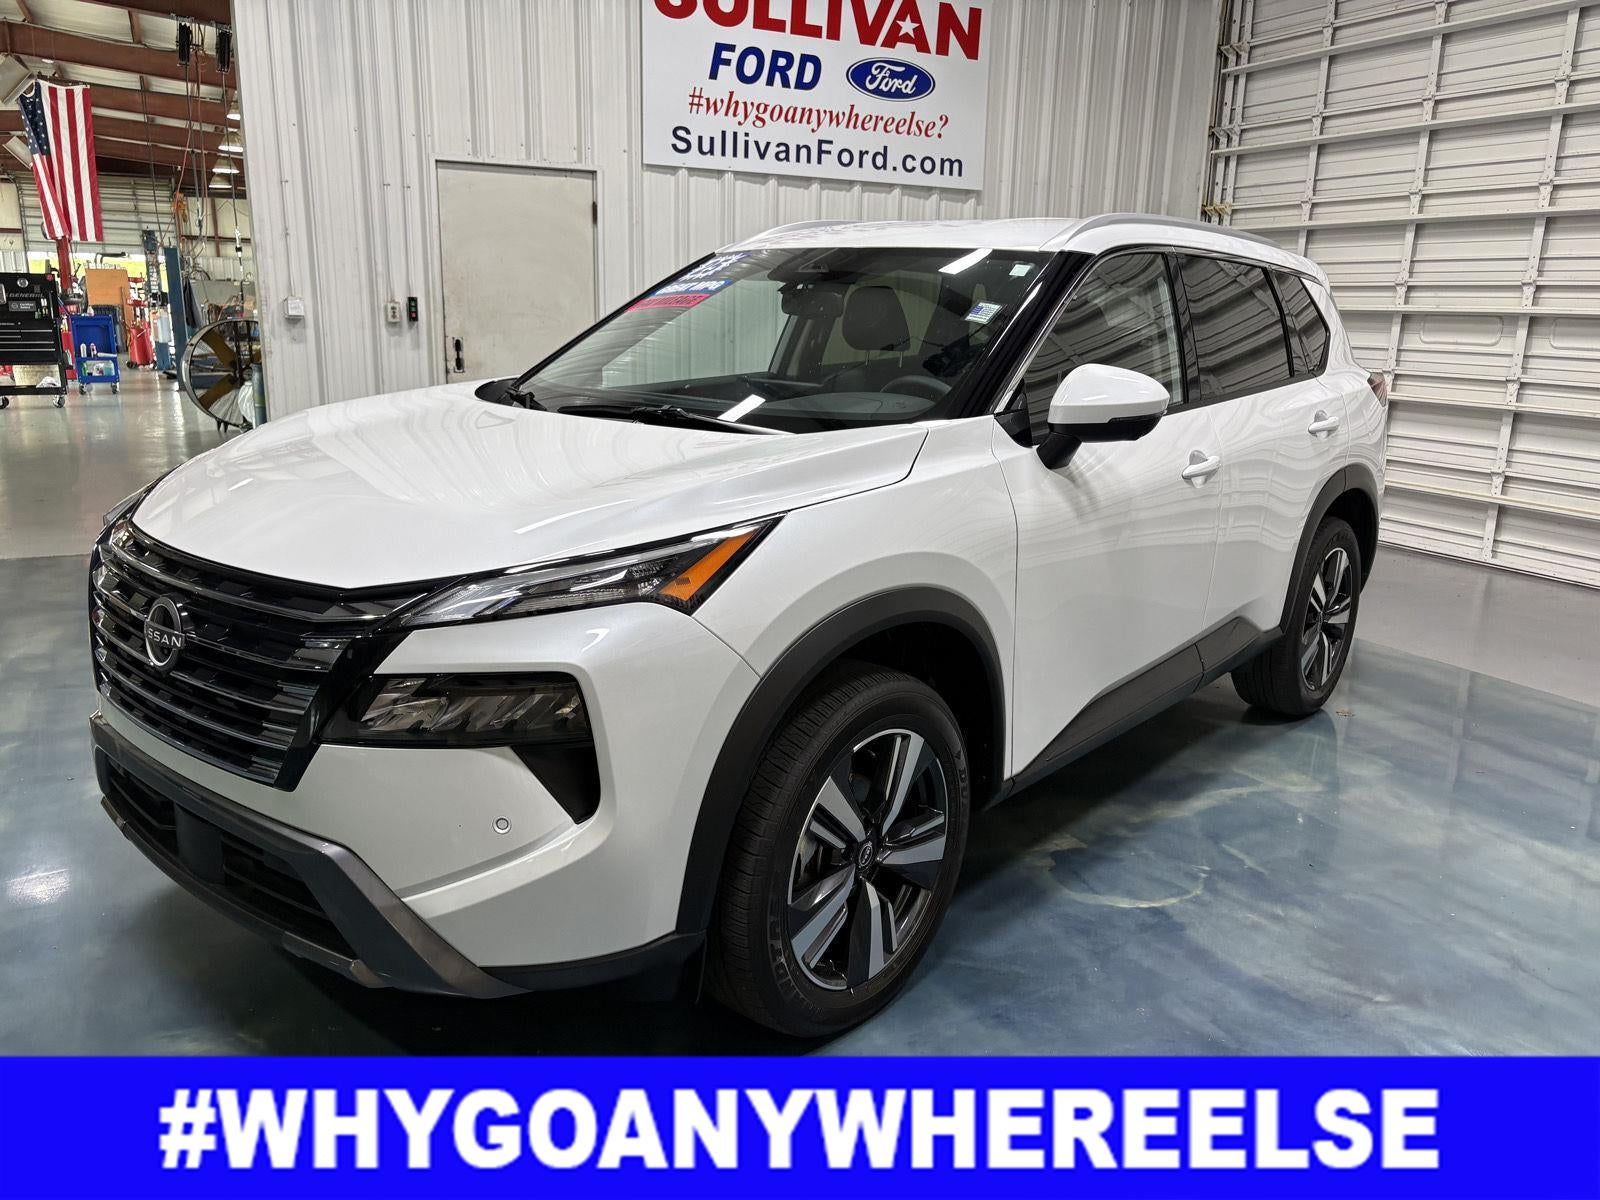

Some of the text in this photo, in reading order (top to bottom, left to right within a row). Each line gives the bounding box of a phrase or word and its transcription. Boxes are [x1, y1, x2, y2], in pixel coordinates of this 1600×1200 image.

[708, 42, 822, 91] FORD
[865, 62, 918, 95] Ford
[688, 87, 949, 139] #whygoanywhereelse?
[671, 125, 964, 178] SullivanFord.com
[147, 627, 182, 648] SSAN
